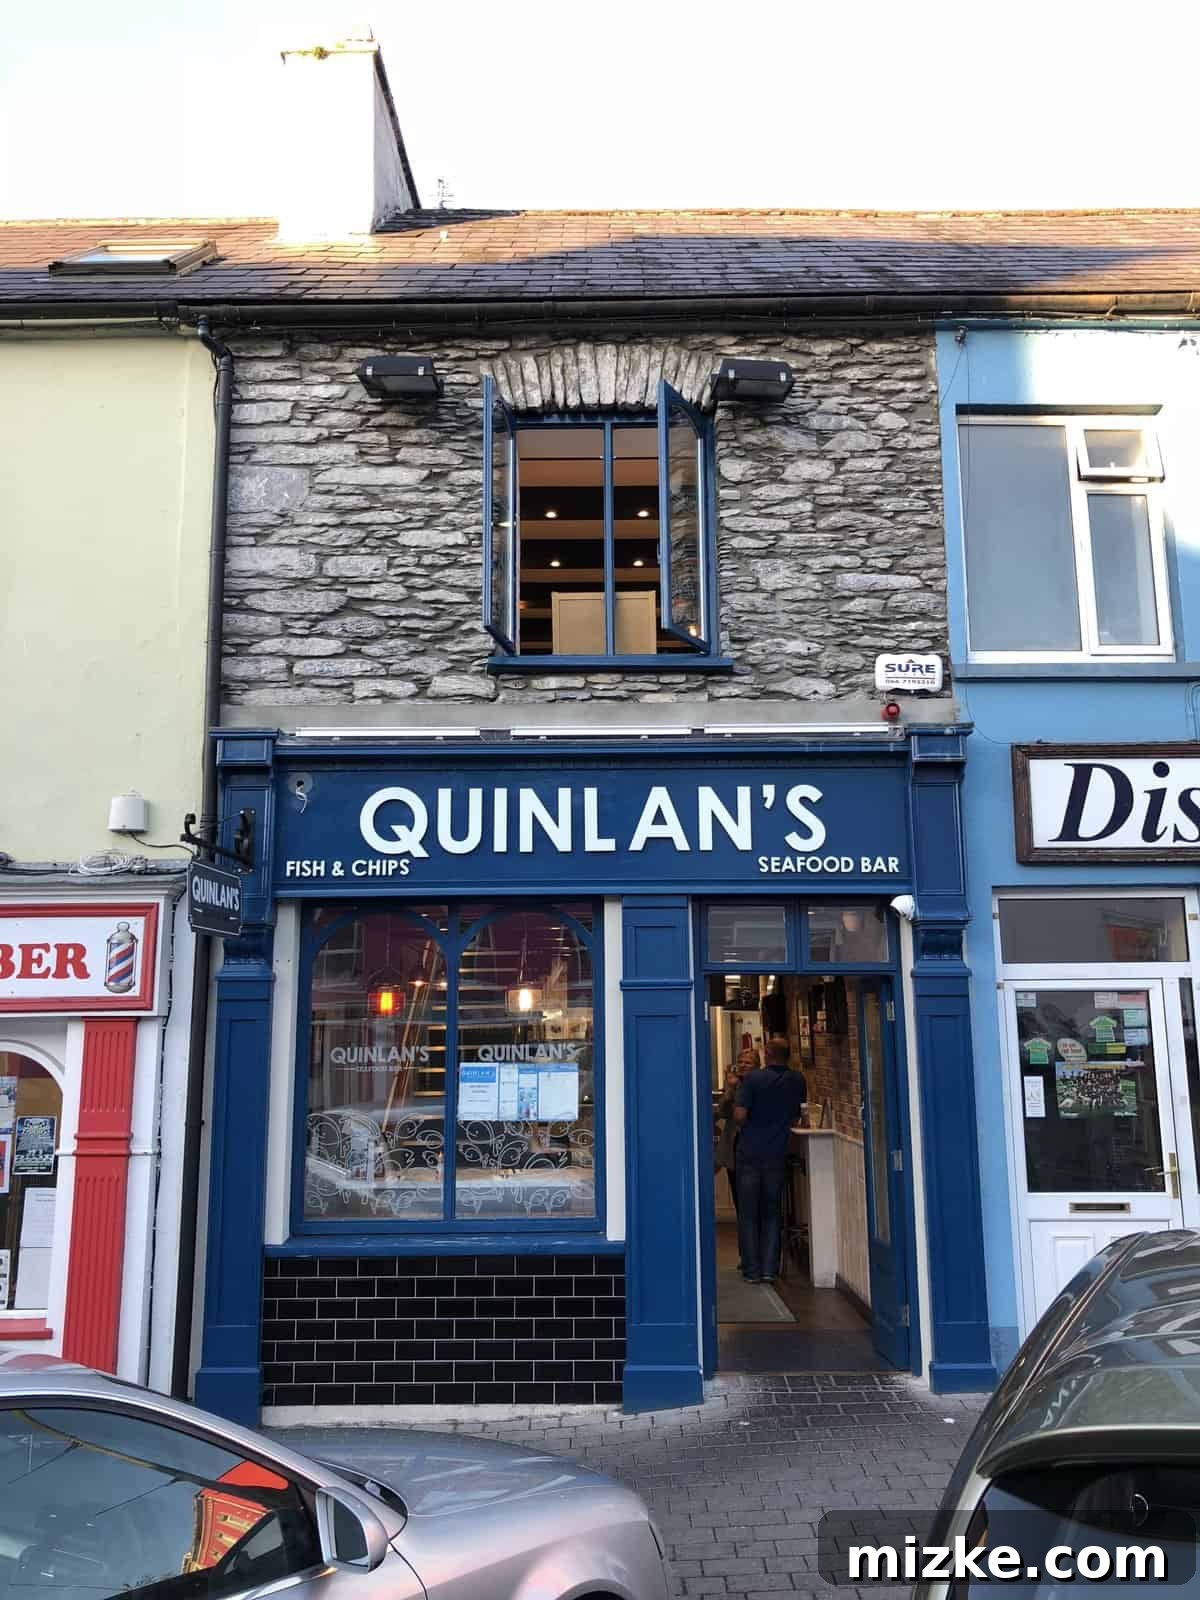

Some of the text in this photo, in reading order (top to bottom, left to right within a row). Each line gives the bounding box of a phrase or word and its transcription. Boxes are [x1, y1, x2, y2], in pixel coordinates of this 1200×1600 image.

[885, 663, 937, 676] SURE
[359, 784, 826, 858] QUINLAN'S
[285, 858, 410, 877] FISH & CHIPS
[757, 856, 899, 873] SEAFOOD BAR
[192, 875, 239, 911] QUINLAN'S
[330, 1045, 430, 1064] QUINLAN'S
[477, 1043, 577, 1062] QUINLAN'S
